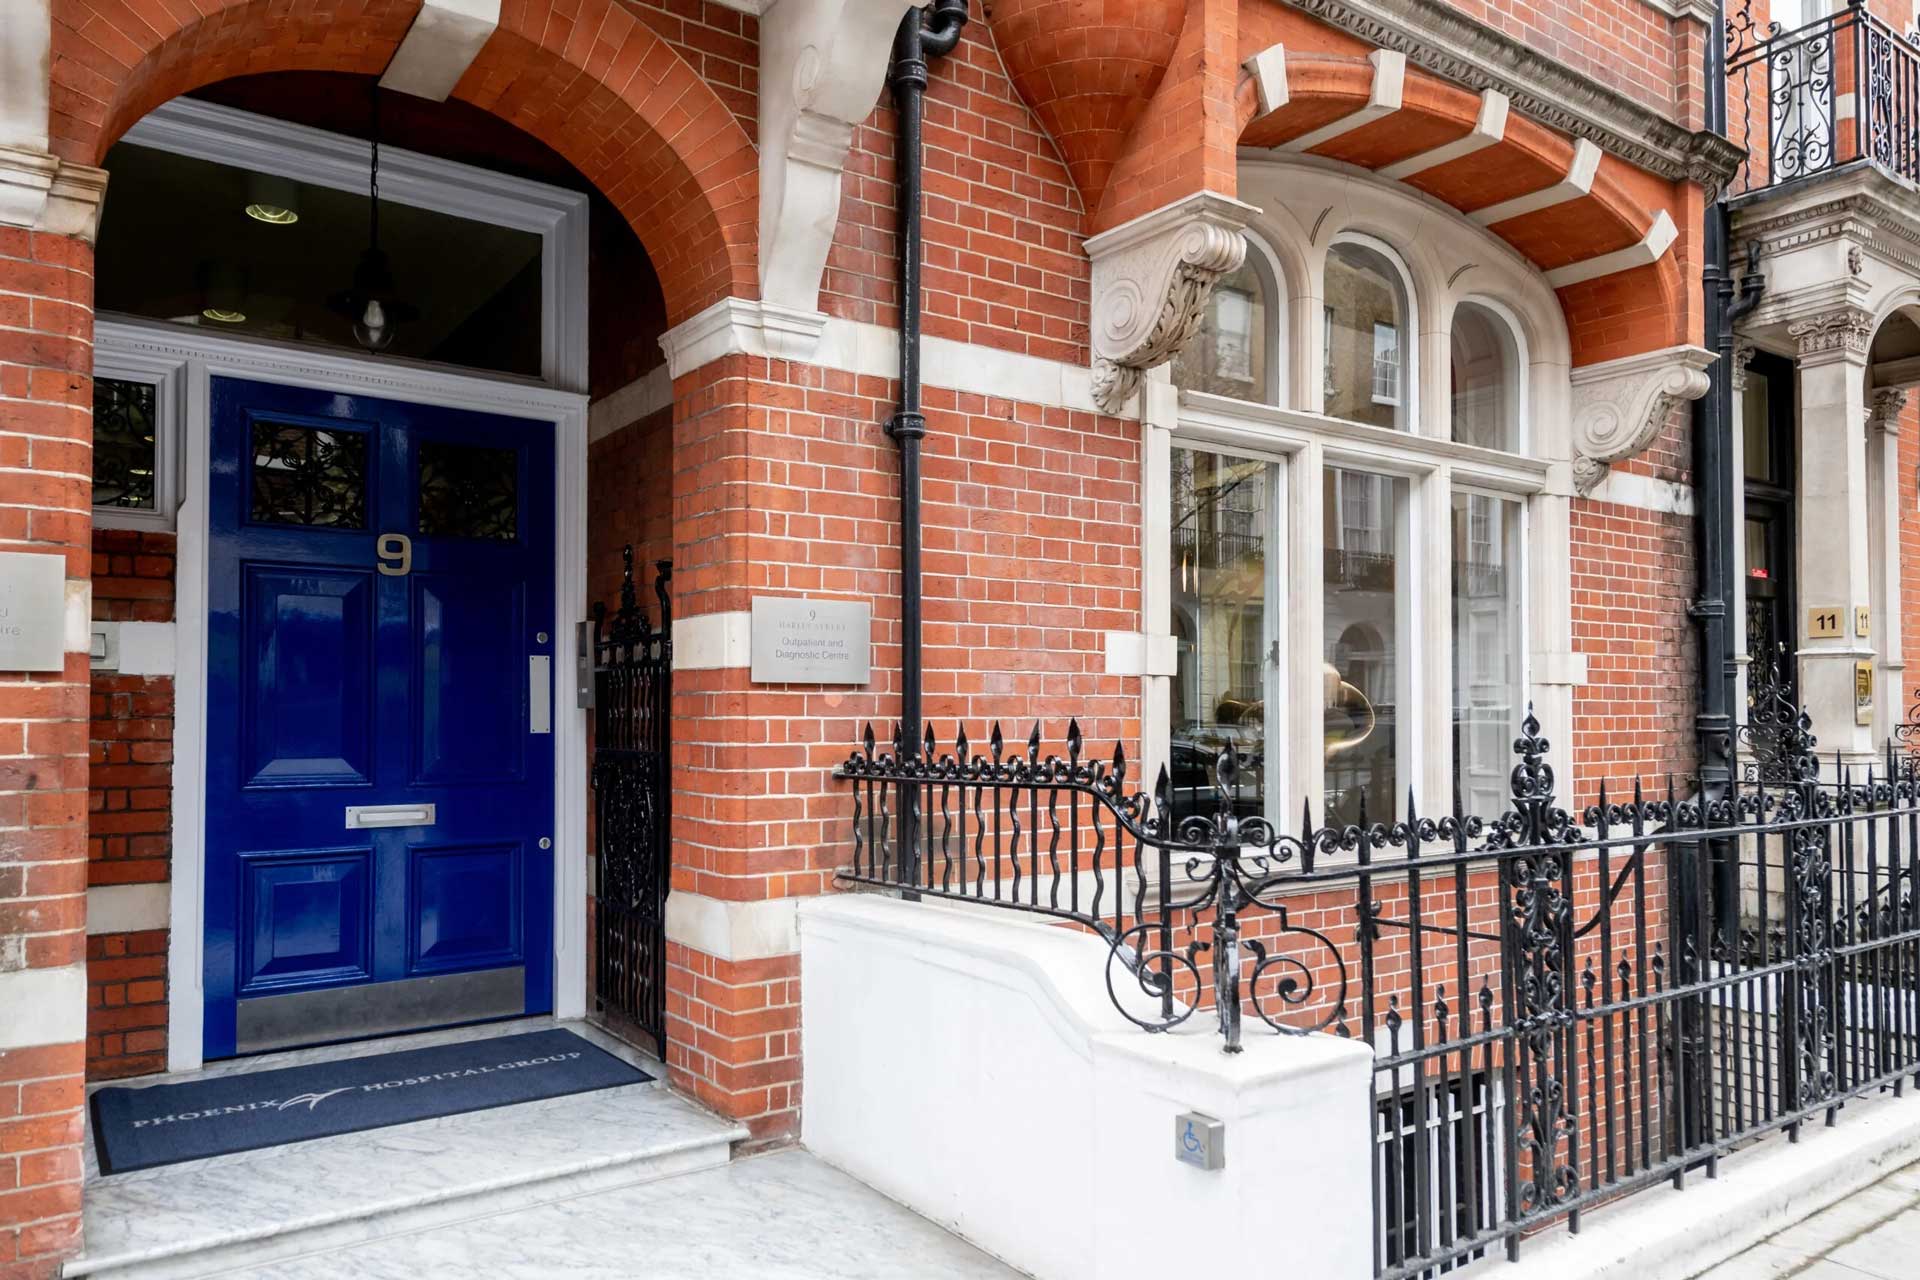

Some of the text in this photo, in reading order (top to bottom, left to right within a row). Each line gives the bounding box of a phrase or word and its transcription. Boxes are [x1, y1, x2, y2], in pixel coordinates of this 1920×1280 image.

[377, 533, 412, 576] 9
[809, 609, 817, 621] 9
[1816, 613, 1837, 630] 11
[1859, 612, 1868, 629] 11
[782, 637, 844, 649] Outpatient and
[776, 649, 849, 661] Diagnostic Centre
[132, 1051, 583, 1129] PHOENIX HOSPITAL GROUP
